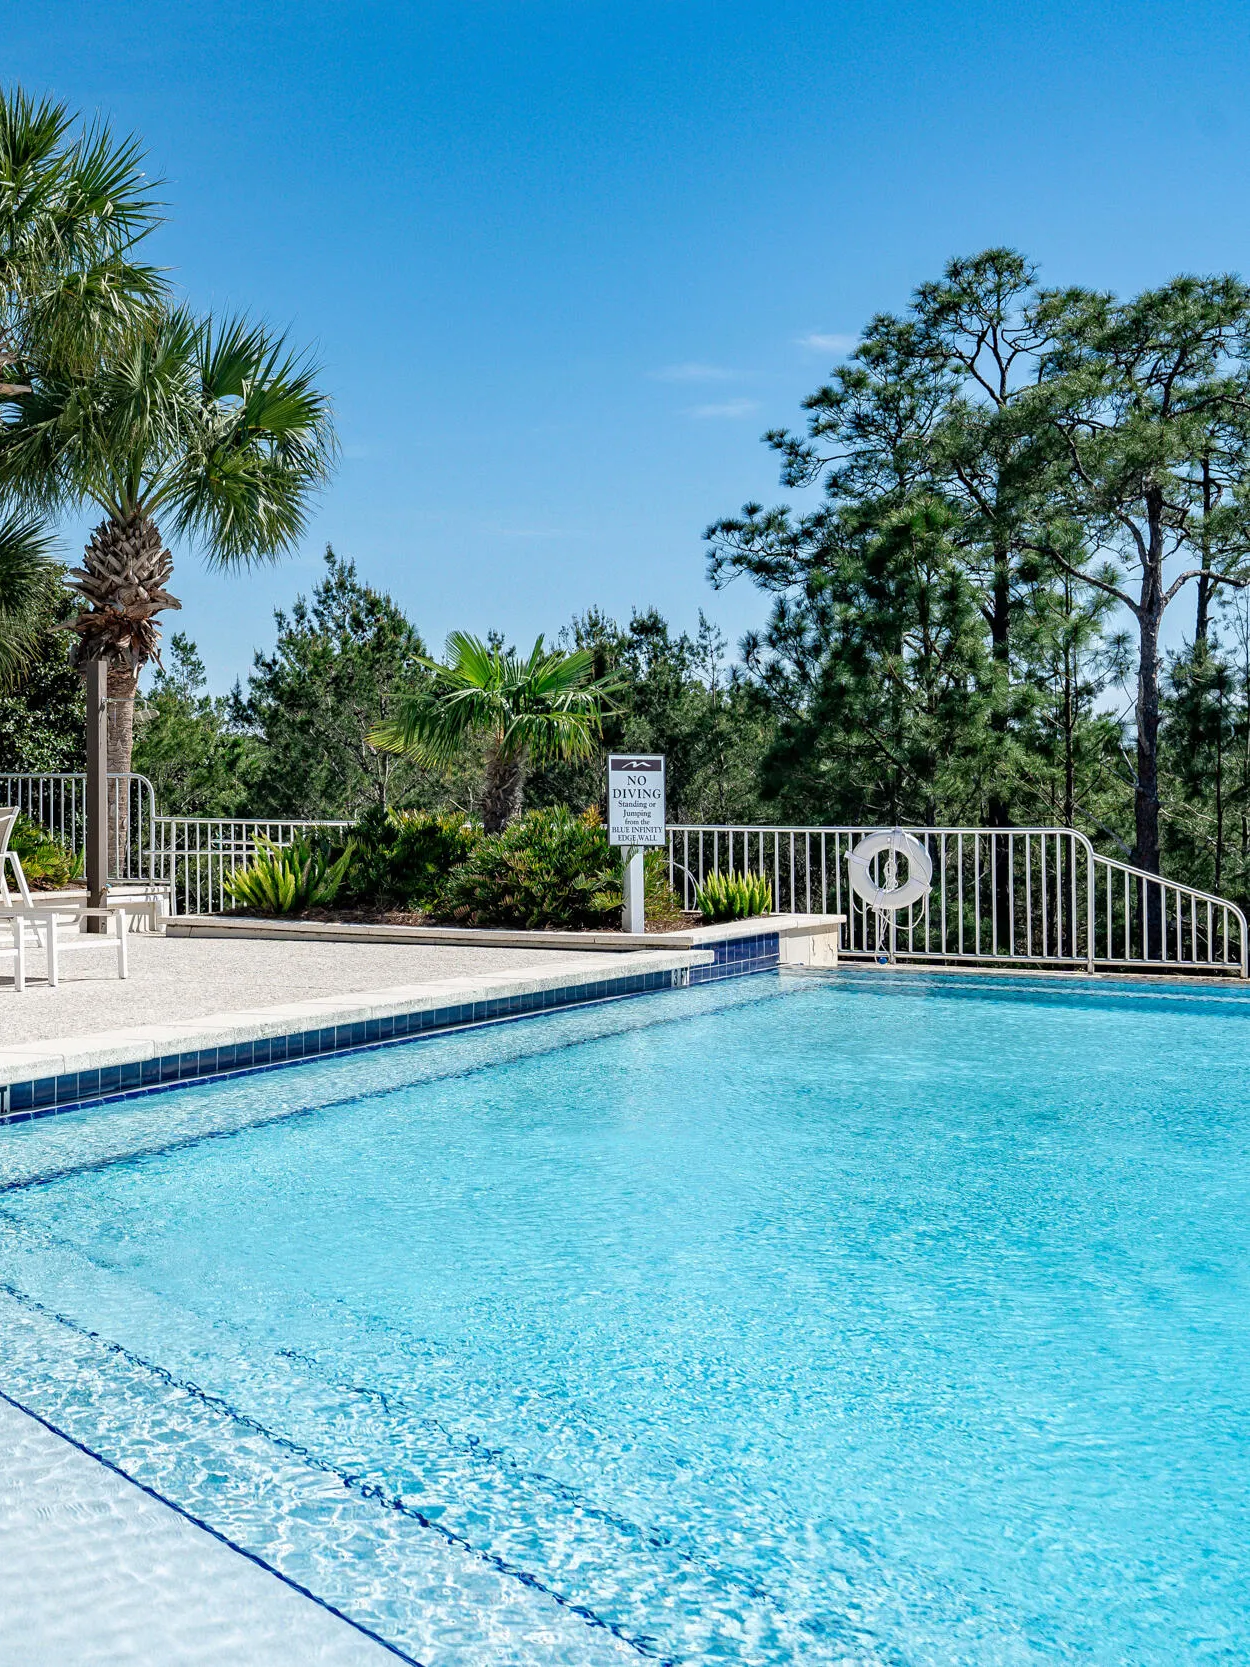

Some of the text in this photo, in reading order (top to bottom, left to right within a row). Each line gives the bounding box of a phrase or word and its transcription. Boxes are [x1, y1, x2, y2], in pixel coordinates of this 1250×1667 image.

[627, 775, 647, 786] NO
[612, 788, 661, 799] DIVING
[618, 800, 648, 808] Standing
[622, 809, 652, 818] Jumping
[673, 968, 678, 986] 3
